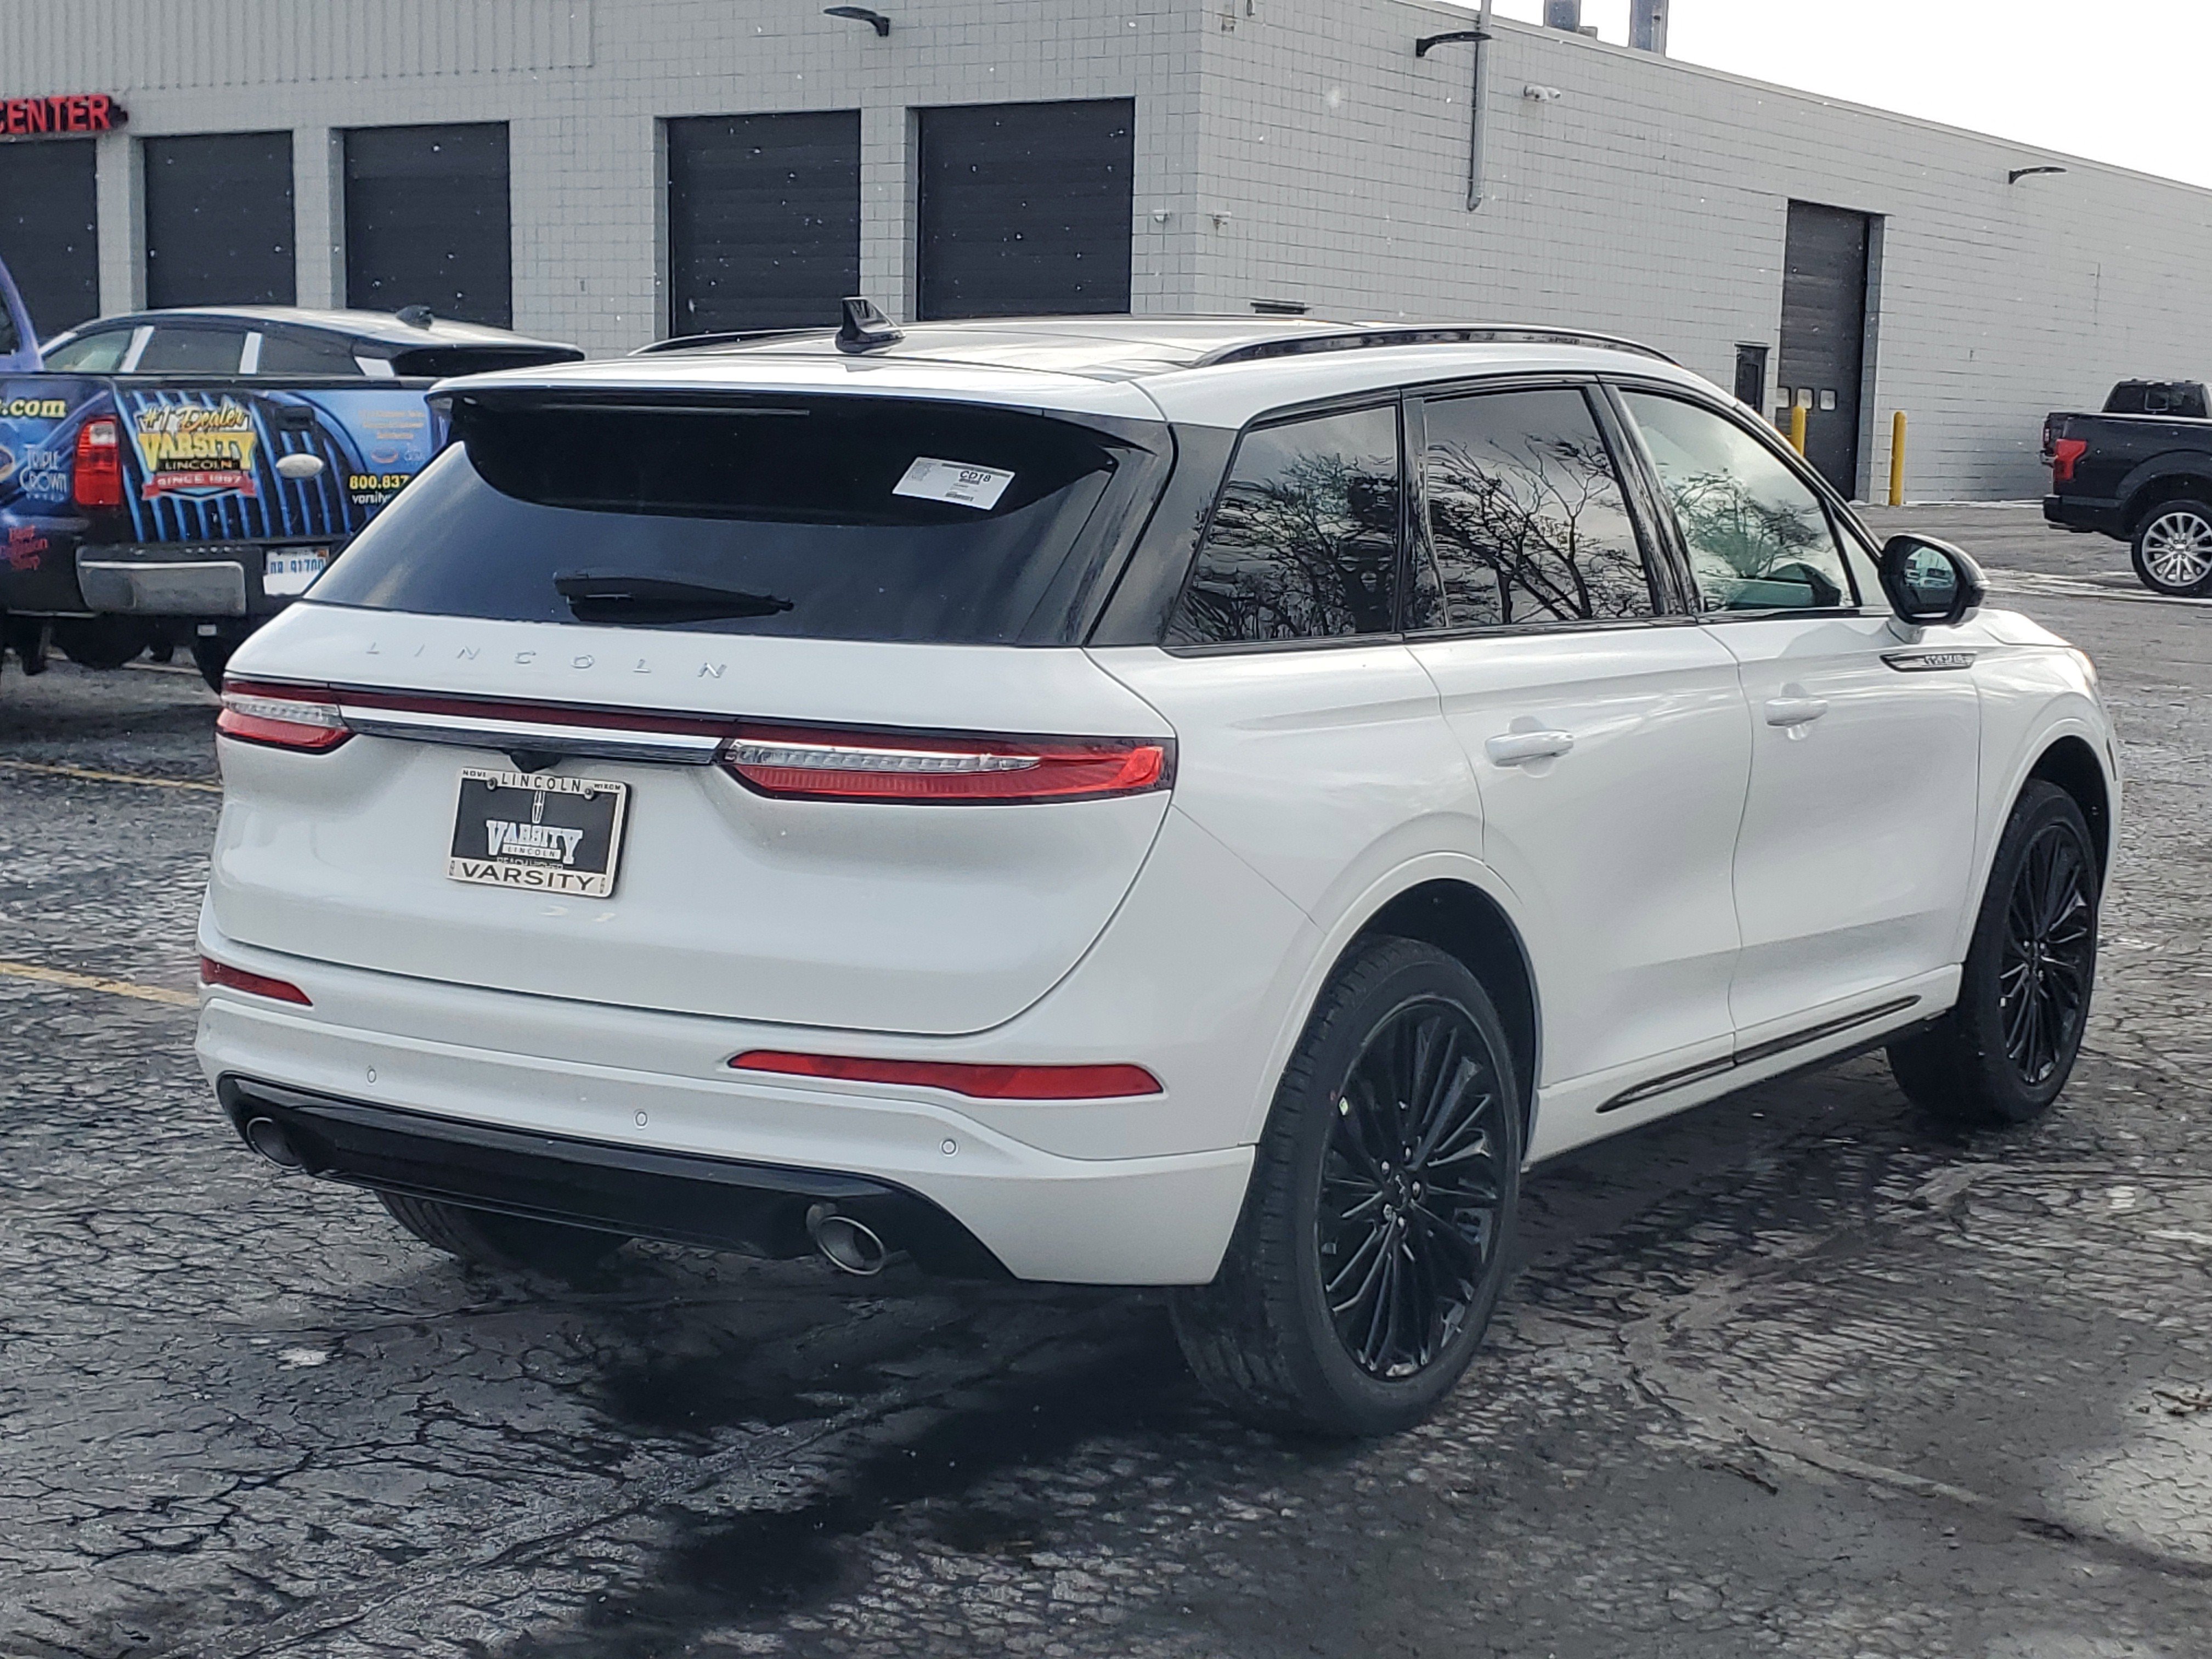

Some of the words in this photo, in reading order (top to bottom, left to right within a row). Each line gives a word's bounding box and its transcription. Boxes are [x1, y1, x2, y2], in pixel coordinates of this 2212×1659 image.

[0, 93, 111, 135] ENTER
[0, 399, 66, 417] .com
[143, 405, 171, 427] #1
[174, 400, 245, 432] Dealer
[138, 431, 256, 472] VARSITY
[165, 459, 233, 471] LINCOLN
[157, 474, 205, 486] SINCE
[349, 474, 411, 490] 800.837
[960, 470, 992, 483] CD18
[366, 642, 727, 679] LINCOLN
[462, 770, 487, 778] NOVI
[501, 773, 582, 792] LINCOLN
[486, 820, 583, 865] VARSITY
[507, 845, 557, 858] LINCOLN
[462, 862, 595, 891] VARSITY
